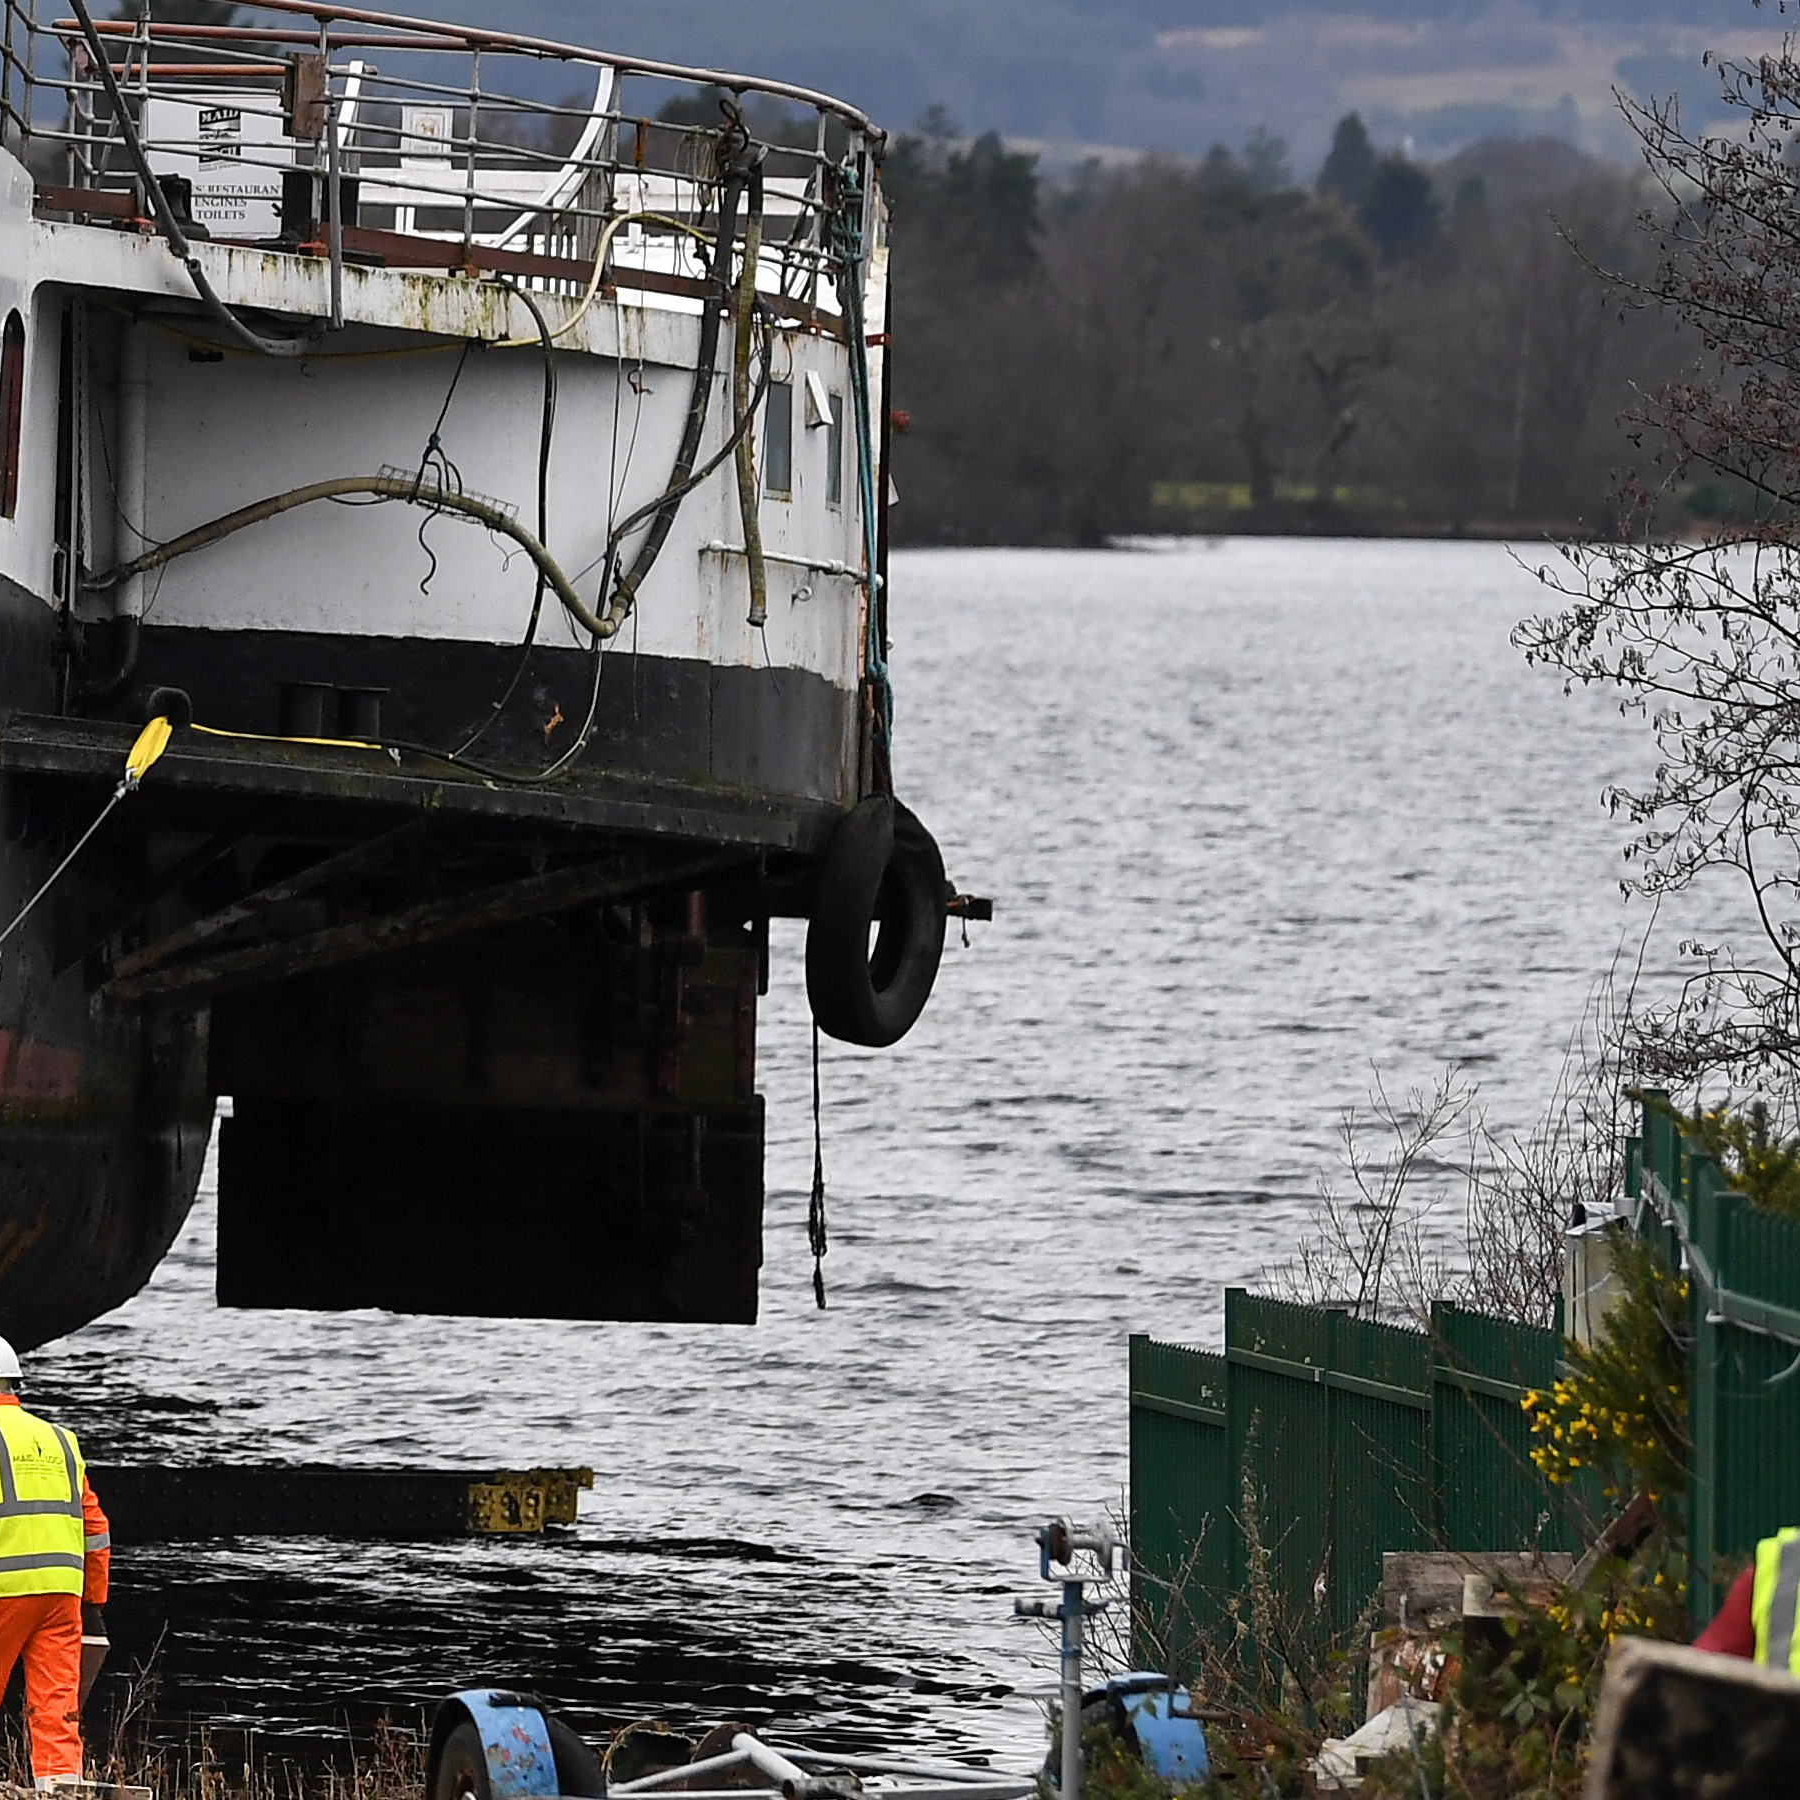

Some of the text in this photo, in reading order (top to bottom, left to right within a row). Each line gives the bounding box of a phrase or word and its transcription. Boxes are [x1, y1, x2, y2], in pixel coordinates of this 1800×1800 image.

[201, 109, 239, 123] MAID
[207, 185, 281, 195] RESTAURAN
[194, 197, 248, 207] ENGINES
[196, 209, 246, 220] TOILETS
